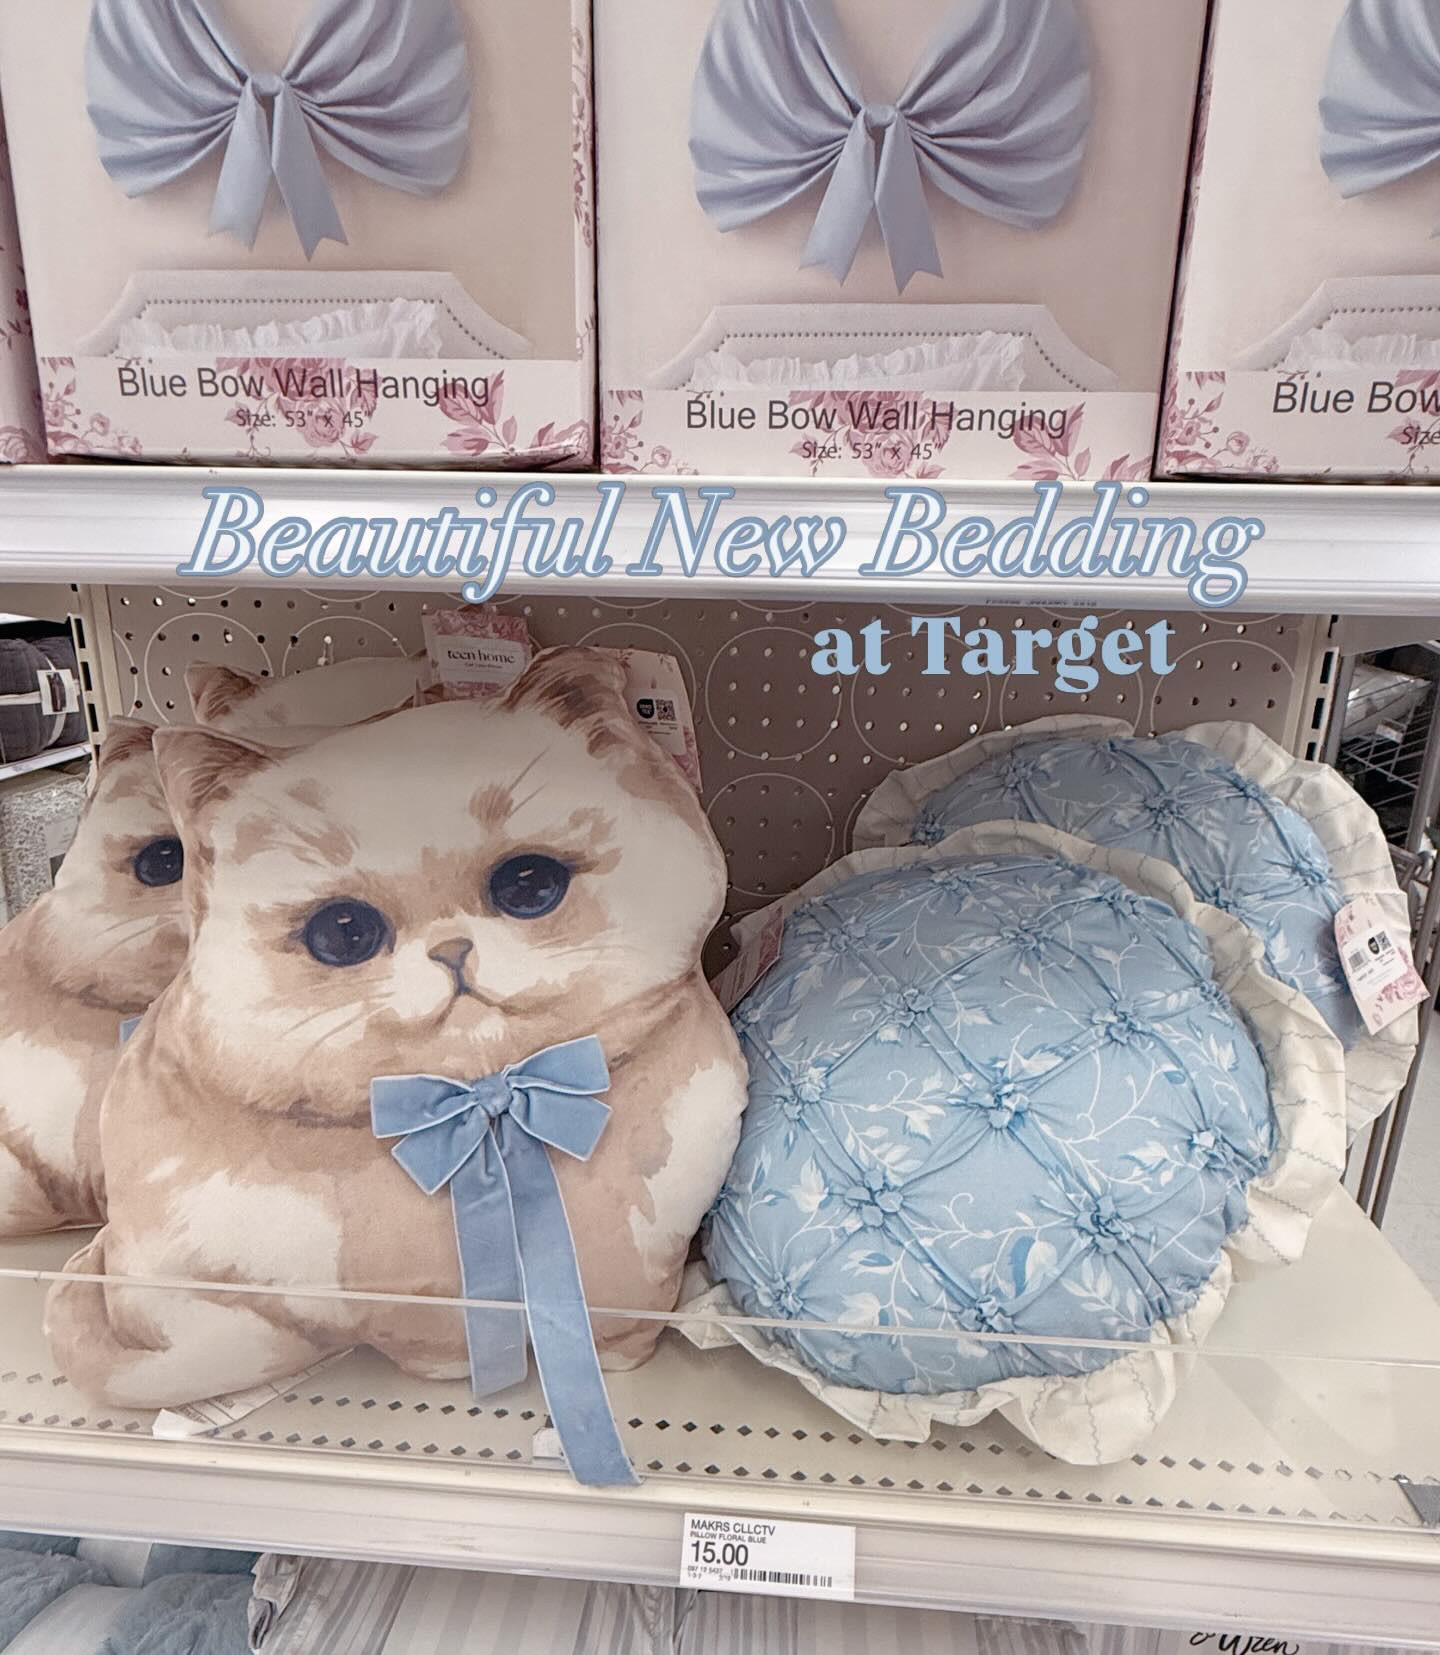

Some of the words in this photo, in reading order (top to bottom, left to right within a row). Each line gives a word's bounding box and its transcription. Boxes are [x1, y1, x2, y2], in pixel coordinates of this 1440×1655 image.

[117, 367, 188, 397] Blue
[197, 367, 264, 397] Bow
[274, 367, 344, 398] Wall
[356, 367, 489, 408] Hanging
[1272, 381, 1354, 414] Blue
[236, 409, 277, 428] Size:
[323, 414, 335, 428] x
[686, 399, 756, 430] Blue
[768, 400, 837, 430] Bow
[848, 400, 918, 431] Wall
[931, 401, 1068, 439] Hanging
[801, 441, 842, 459] Size:
[890, 446, 902, 460] x
[447, 650, 476, 661] teen
[478, 649, 516, 664] home
[691, 1519, 730, 1532] MAKRS
[733, 1522, 775, 1536] CLLCTV
[690, 1531, 717, 1540] PILLOW
[718, 1533, 746, 1542] FLORAL
[747, 1536, 767, 1544] BLUE
[691, 1540, 749, 1566] 15.00
